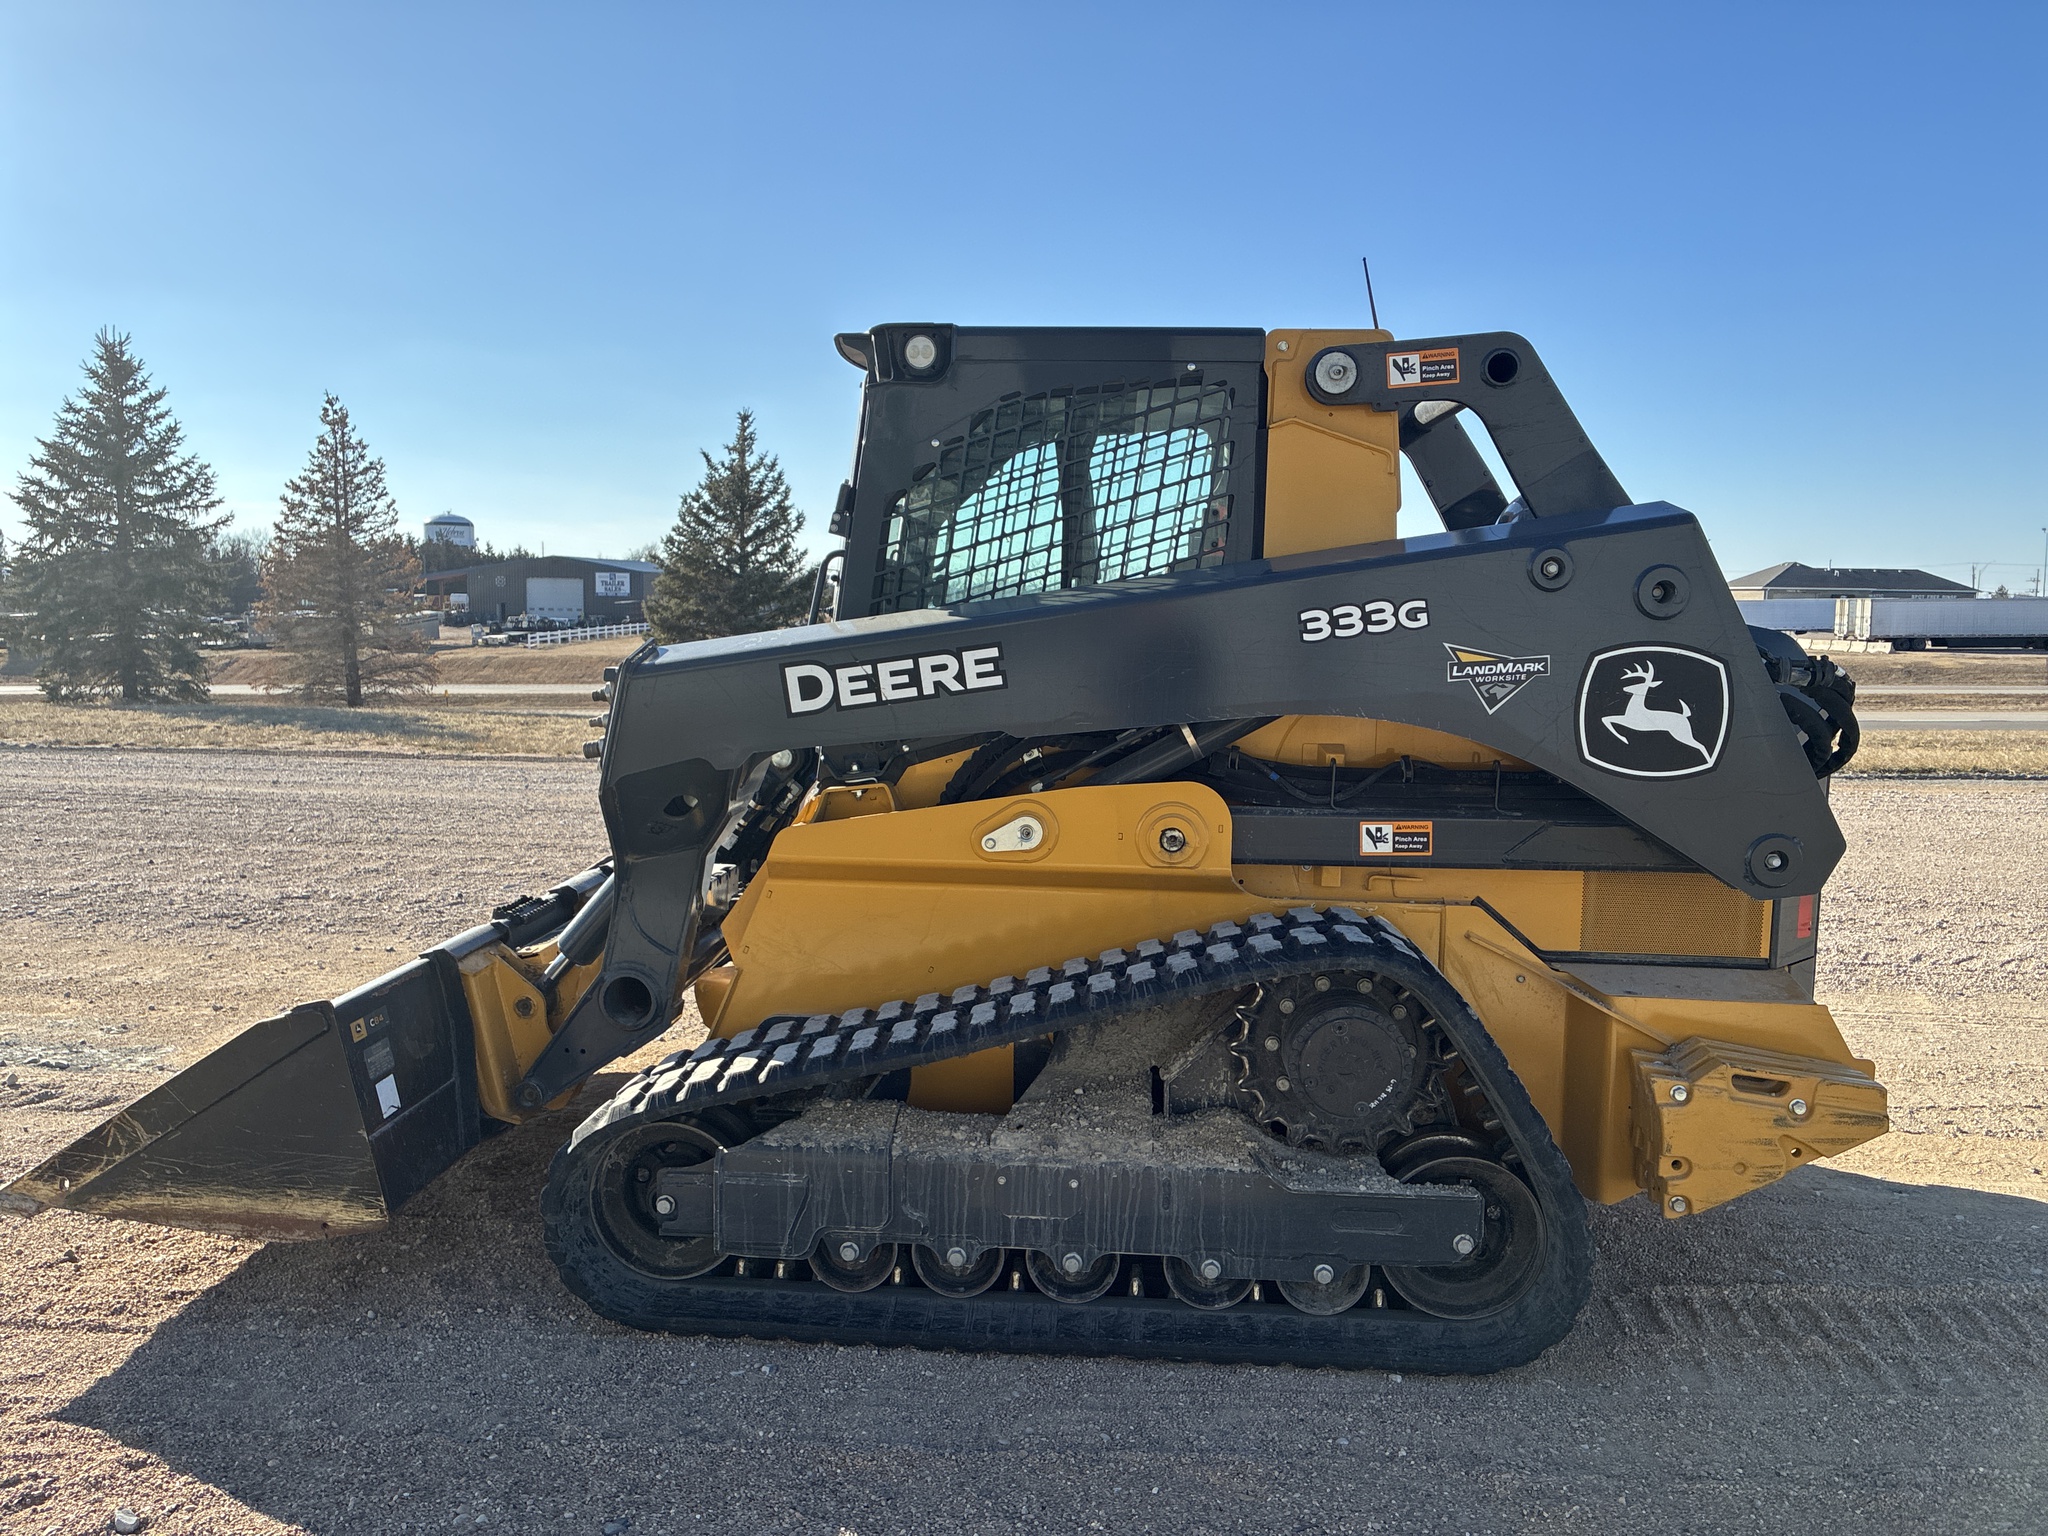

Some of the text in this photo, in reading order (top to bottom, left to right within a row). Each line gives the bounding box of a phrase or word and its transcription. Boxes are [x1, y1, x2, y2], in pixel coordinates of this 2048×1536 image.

[1428, 351, 1455, 359] WARNING
[1422, 364, 1439, 372] Pinch
[1299, 599, 1429, 642] 333G
[1451, 661, 1546, 676] LANDMARK
[784, 646, 1004, 714] DEERE
[1475, 673, 1527, 683] WORKSITE
